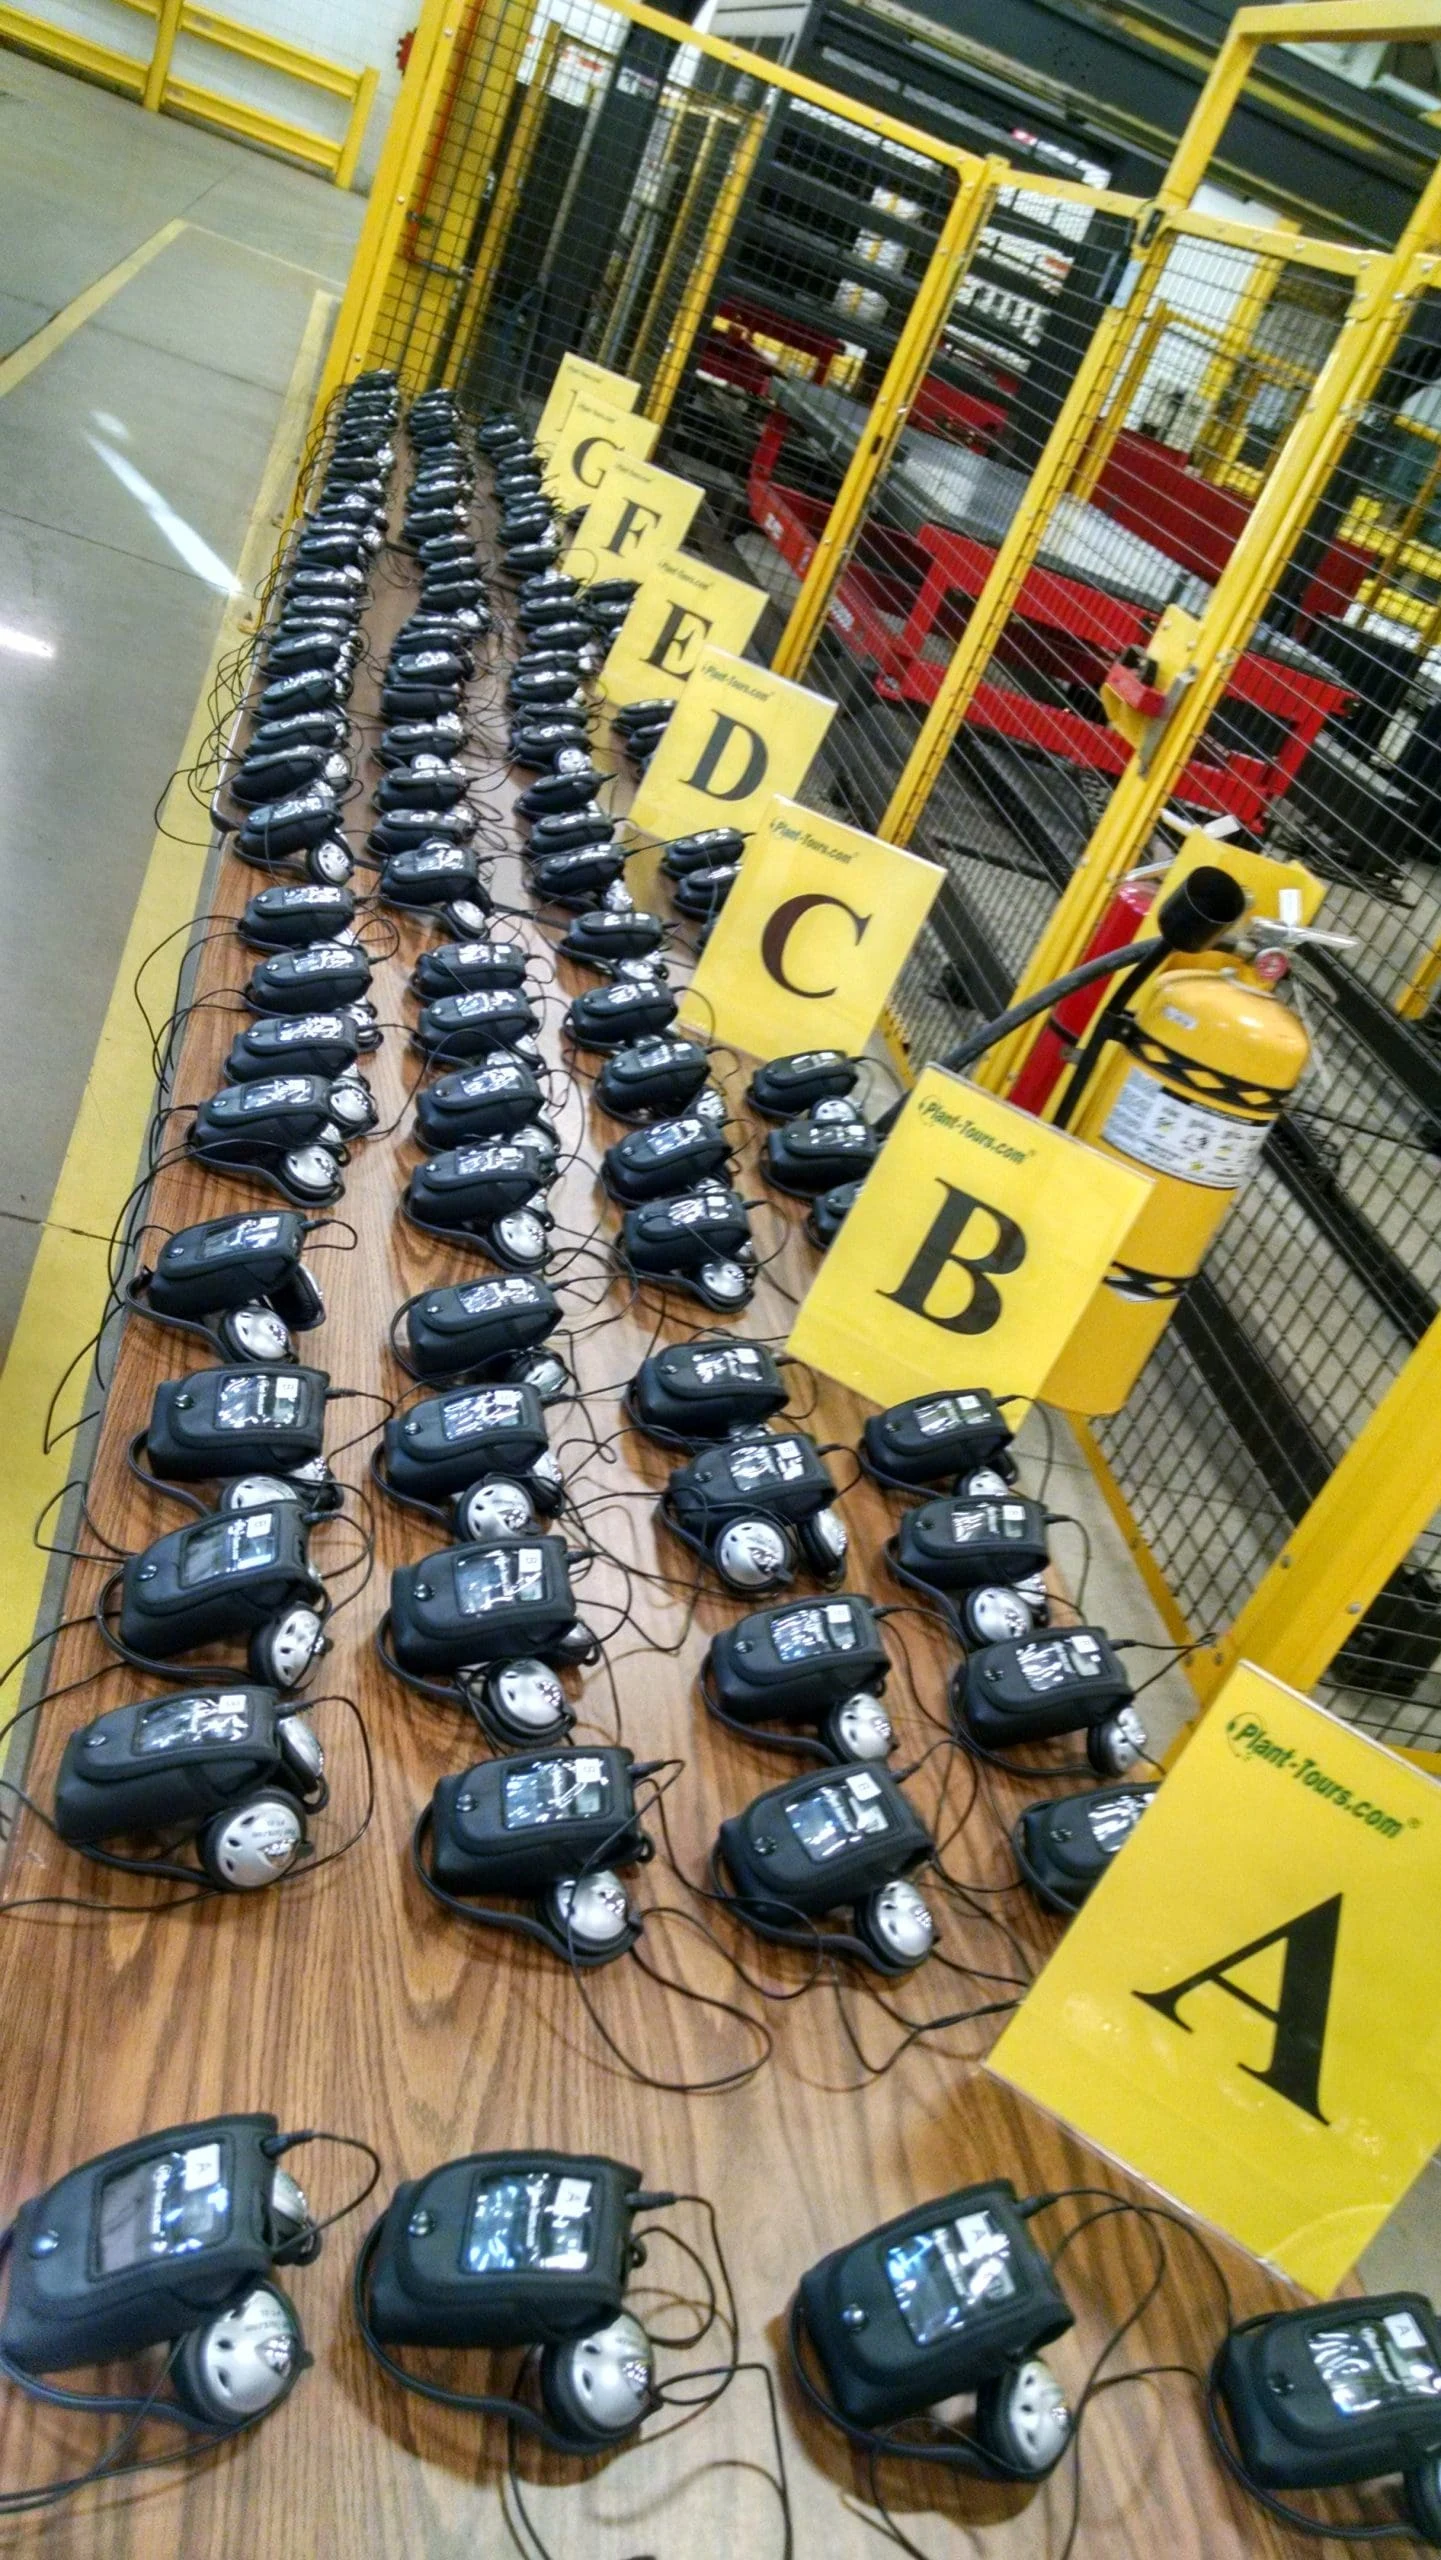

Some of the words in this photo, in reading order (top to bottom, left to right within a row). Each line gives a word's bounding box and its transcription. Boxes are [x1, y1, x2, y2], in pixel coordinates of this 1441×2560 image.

[572, 437, 625, 489] G
[601, 497, 662, 558] F
[639, 600, 713, 682] E
[678, 708, 769, 801] D
[761, 893, 873, 999] C
[924, 1104, 1028, 1164] Plant-Tours.com
[875, 1177, 1027, 1336] B
[1234, 1722, 1403, 1839] Plant-Tours.com
[1131, 1892, 1344, 2127] A
